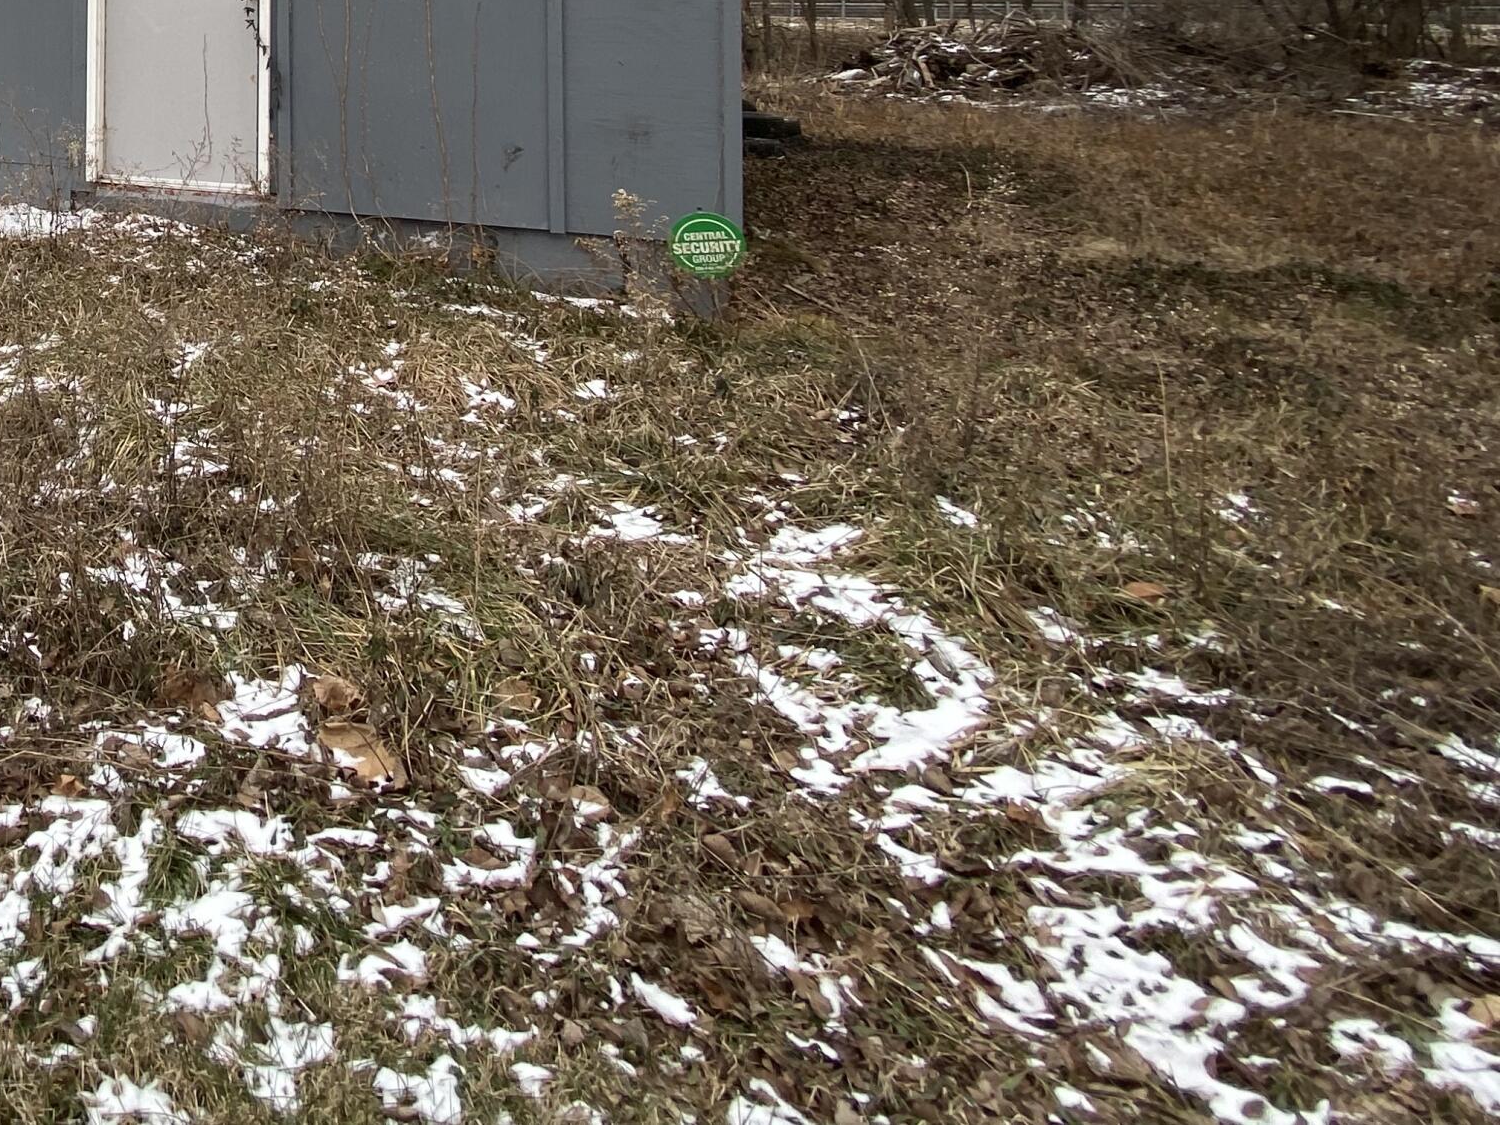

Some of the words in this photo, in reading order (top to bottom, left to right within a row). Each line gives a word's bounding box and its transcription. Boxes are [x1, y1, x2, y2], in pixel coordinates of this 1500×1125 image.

[683, 231, 728, 241] CENTRAL
[672, 240, 741, 254] SECURITY
[692, 254, 726, 263] GROUP
